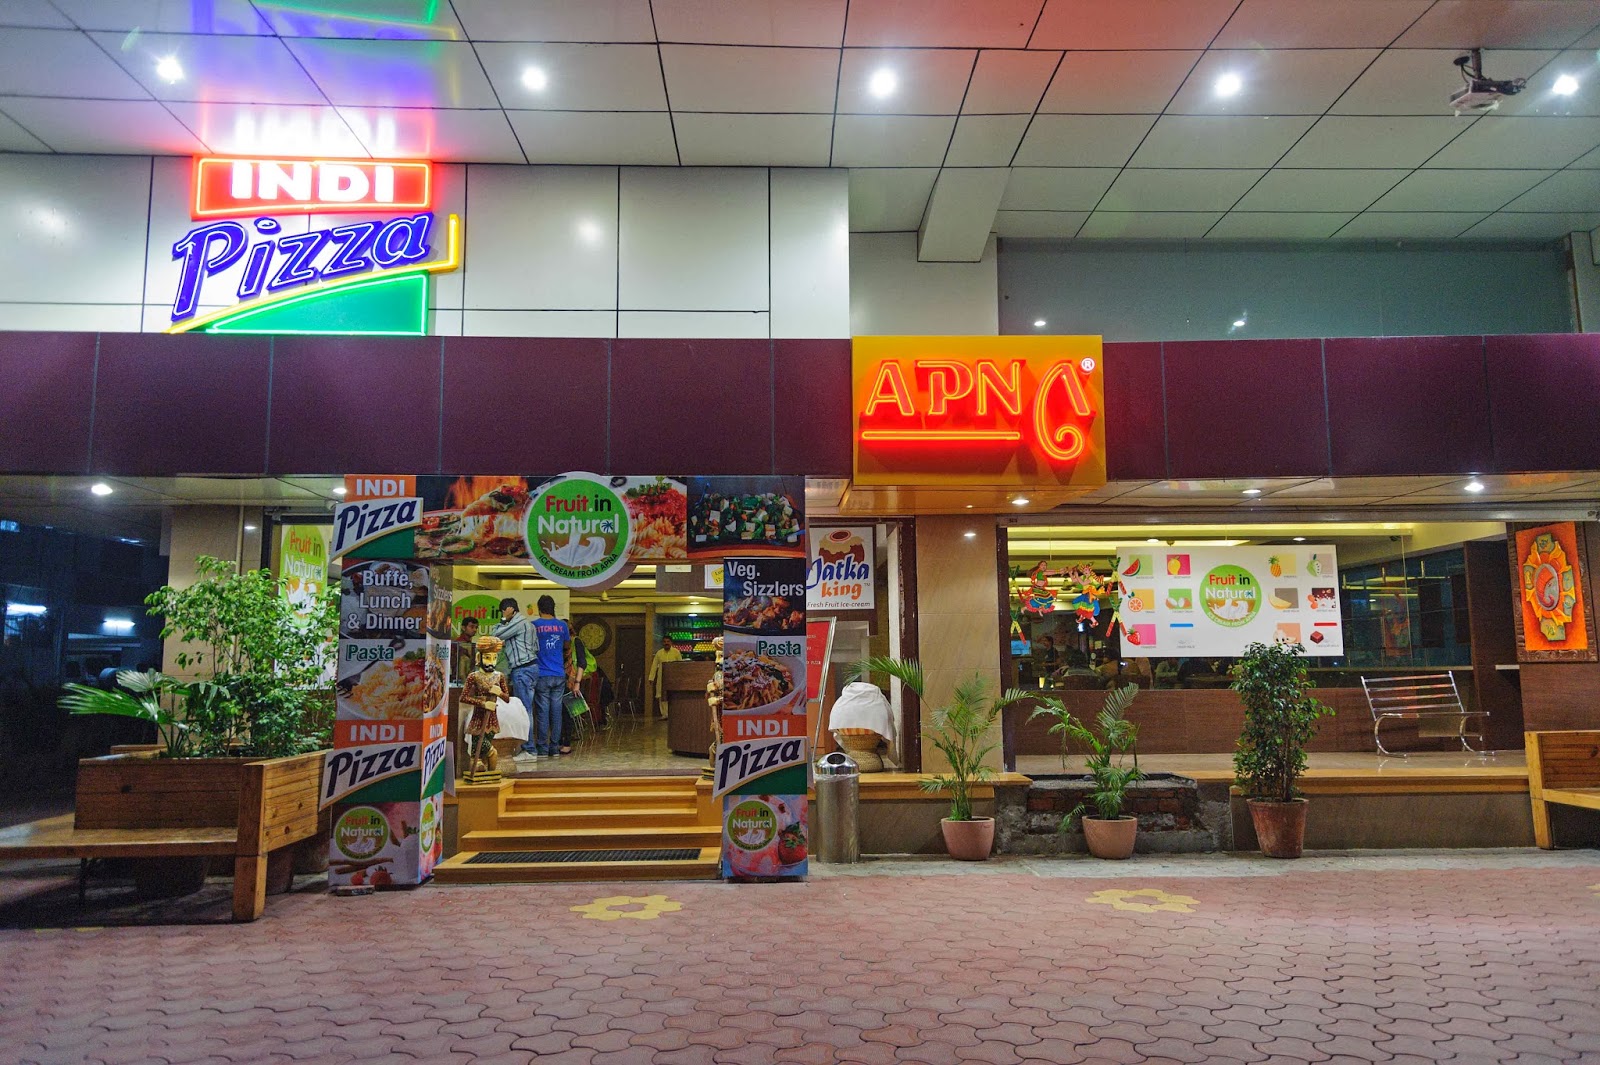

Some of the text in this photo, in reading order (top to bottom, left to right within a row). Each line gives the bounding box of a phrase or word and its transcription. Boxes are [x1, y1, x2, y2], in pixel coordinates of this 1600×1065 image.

[231, 161, 395, 203] INDI
[171, 211, 434, 322] Pizza
[356, 478, 405, 497] INDI
[335, 500, 417, 551] Pizza
[537, 514, 619, 535] Natural
[283, 552, 324, 582] Natural
[539, 553, 618, 577] ICE CREAM FROM APNA
[727, 561, 761, 580] Veg.
[362, 570, 413, 589] Buffe,
[743, 580, 804, 597] Sizzlers
[821, 581, 862, 600] king
[1205, 586, 1256, 599] Natural
[359, 592, 411, 609] Lunch
[347, 613, 423, 630] & Dinner
[346, 644, 395, 661] Pasta
[757, 641, 801, 656] Pasta
[350, 725, 405, 742] INDI
[737, 719, 789, 736] INDI
[326, 744, 417, 799] Pizza
[424, 739, 445, 785] Pizza
[718, 739, 802, 791] Pizza
[341, 825, 384, 837] Natural
[732, 818, 772, 829] Natural
